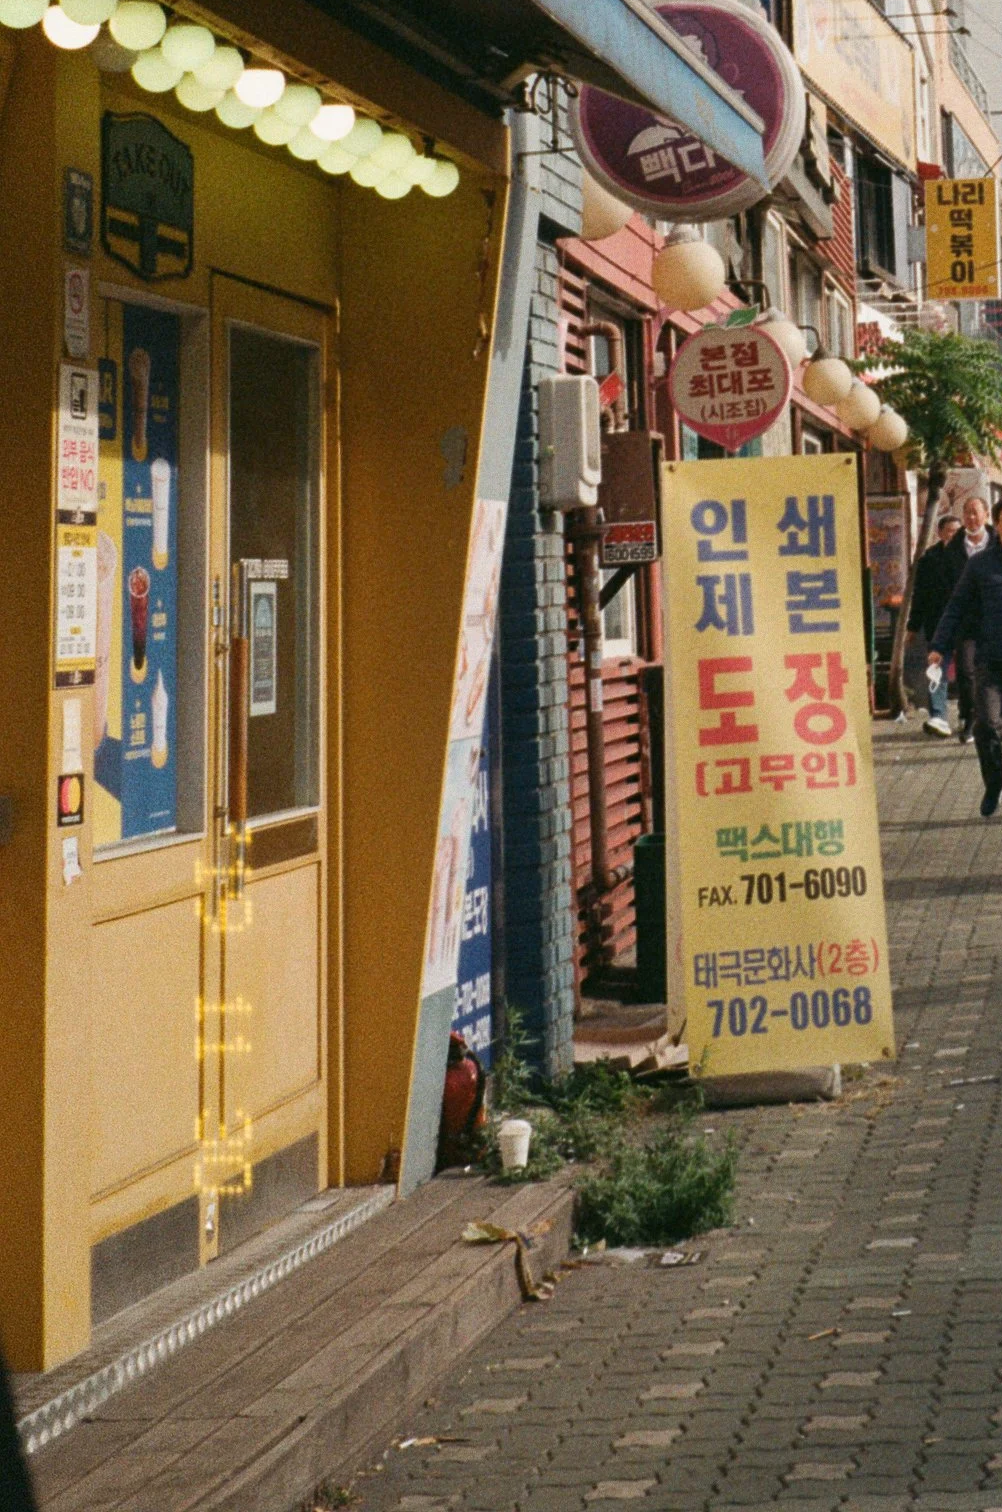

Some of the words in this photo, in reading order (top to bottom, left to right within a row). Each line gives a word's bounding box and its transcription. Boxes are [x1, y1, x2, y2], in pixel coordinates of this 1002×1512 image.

[640, 141, 717, 183] 빽다
[936, 181, 985, 206] 나리
[949, 208, 975, 283] 떡볶이
[700, 340, 760, 372] 본점
[688, 367, 775, 400] 최대포
[700, 397, 768, 422] (시조집)
[690, 494, 838, 563] 인쇄
[694, 568, 842, 637] 제본
[697, 651, 850, 748] 도장
[695, 750, 857, 798] (고무인)
[715, 819, 846, 863] 팩스대행
[697, 884, 738, 908] FAX.
[740, 865, 868, 906] 701-6090
[706, 985, 874, 1038] 702-0068
